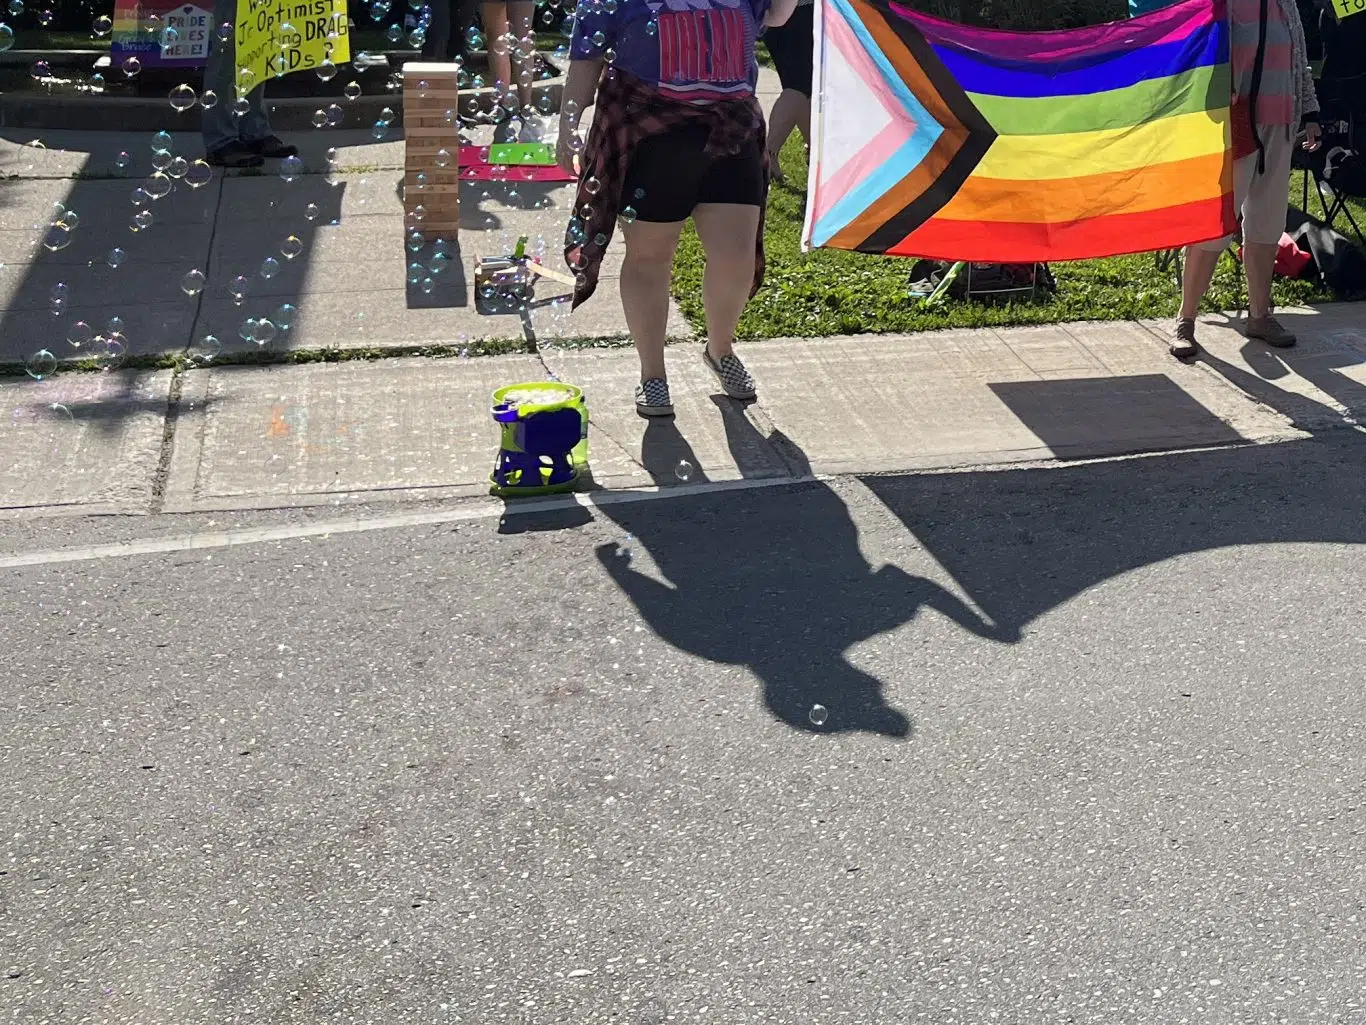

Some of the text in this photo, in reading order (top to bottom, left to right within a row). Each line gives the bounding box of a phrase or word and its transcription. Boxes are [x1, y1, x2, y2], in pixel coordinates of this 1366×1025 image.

[168, 15, 206, 27] PRIDE
[239, 21, 253, 45] Jr
[305, 13, 347, 41] DRAG
[265, 49, 315, 76] KIDs
